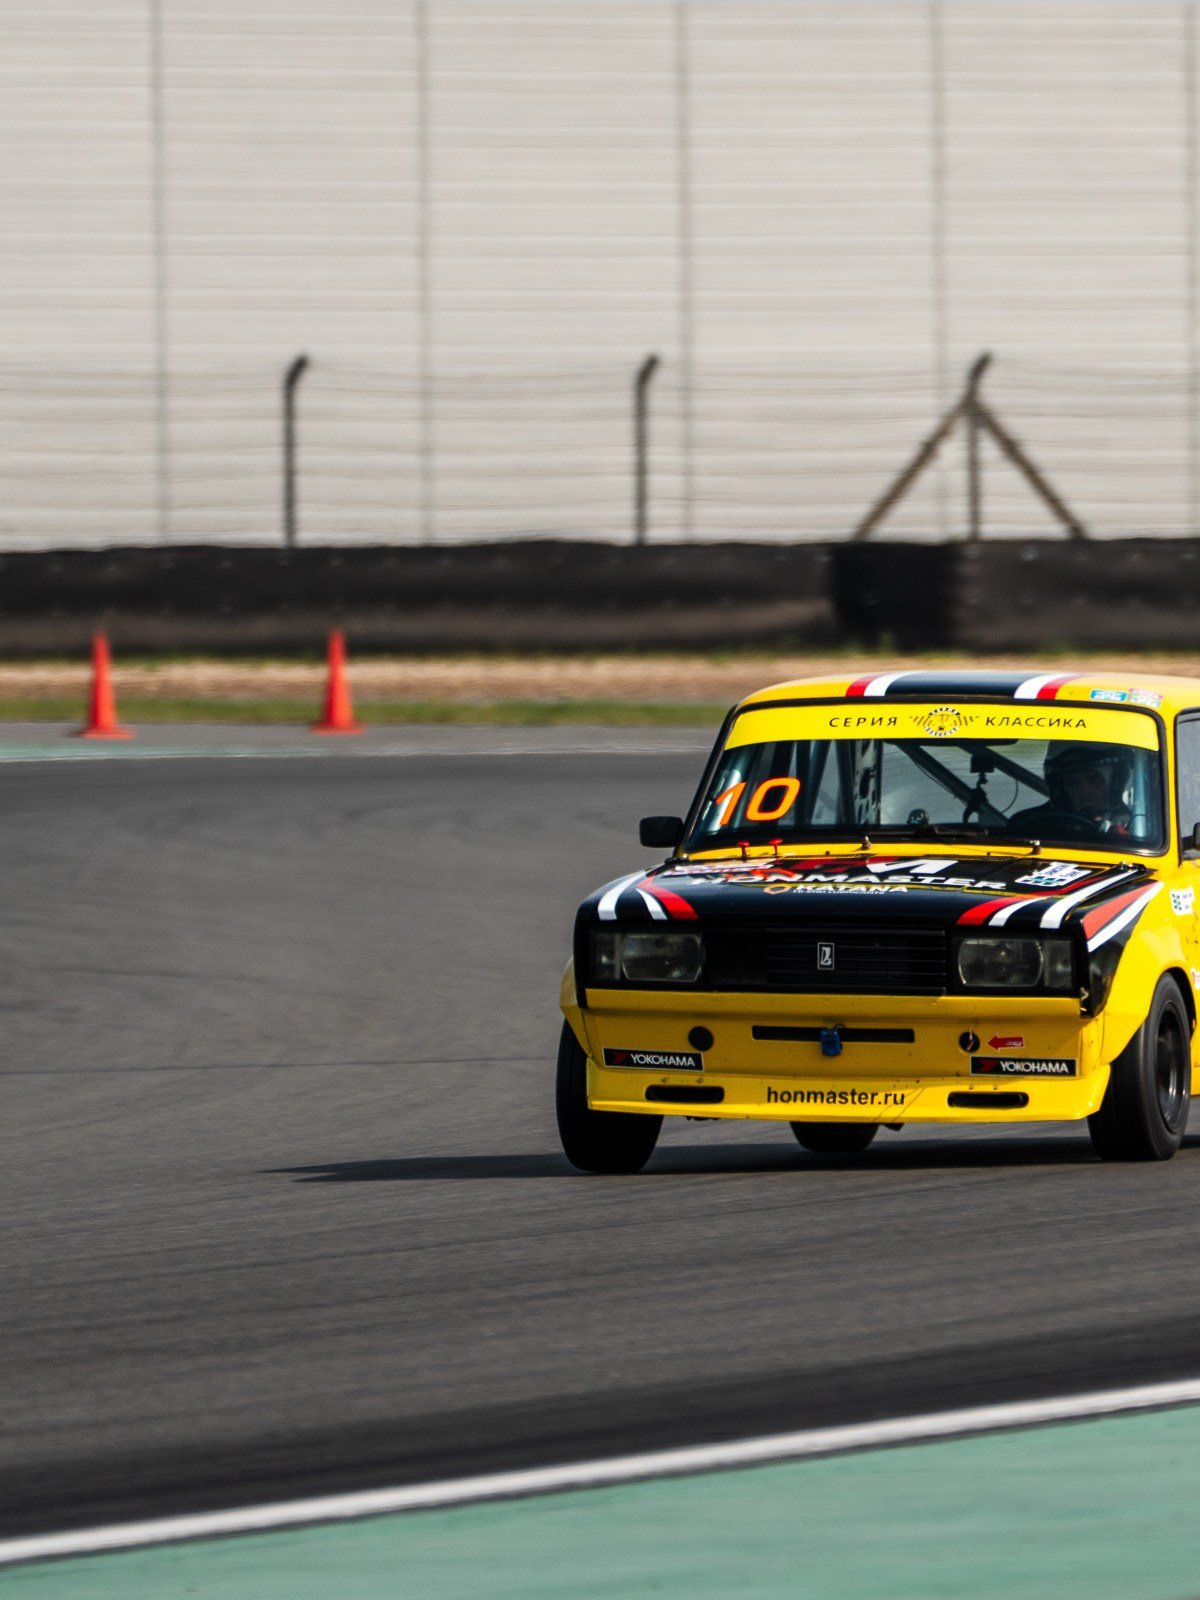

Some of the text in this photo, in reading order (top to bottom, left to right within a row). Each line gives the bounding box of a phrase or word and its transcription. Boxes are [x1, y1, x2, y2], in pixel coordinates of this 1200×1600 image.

[828, 716, 1087, 729] СЕРИЯ КЛАССИКА
[715, 776, 801, 827] 10
[630, 1053, 696, 1067] YOKOHAMA
[1000, 1060, 1069, 1074] YOKOHAMA
[766, 1087, 905, 1105] honmaster.ru
